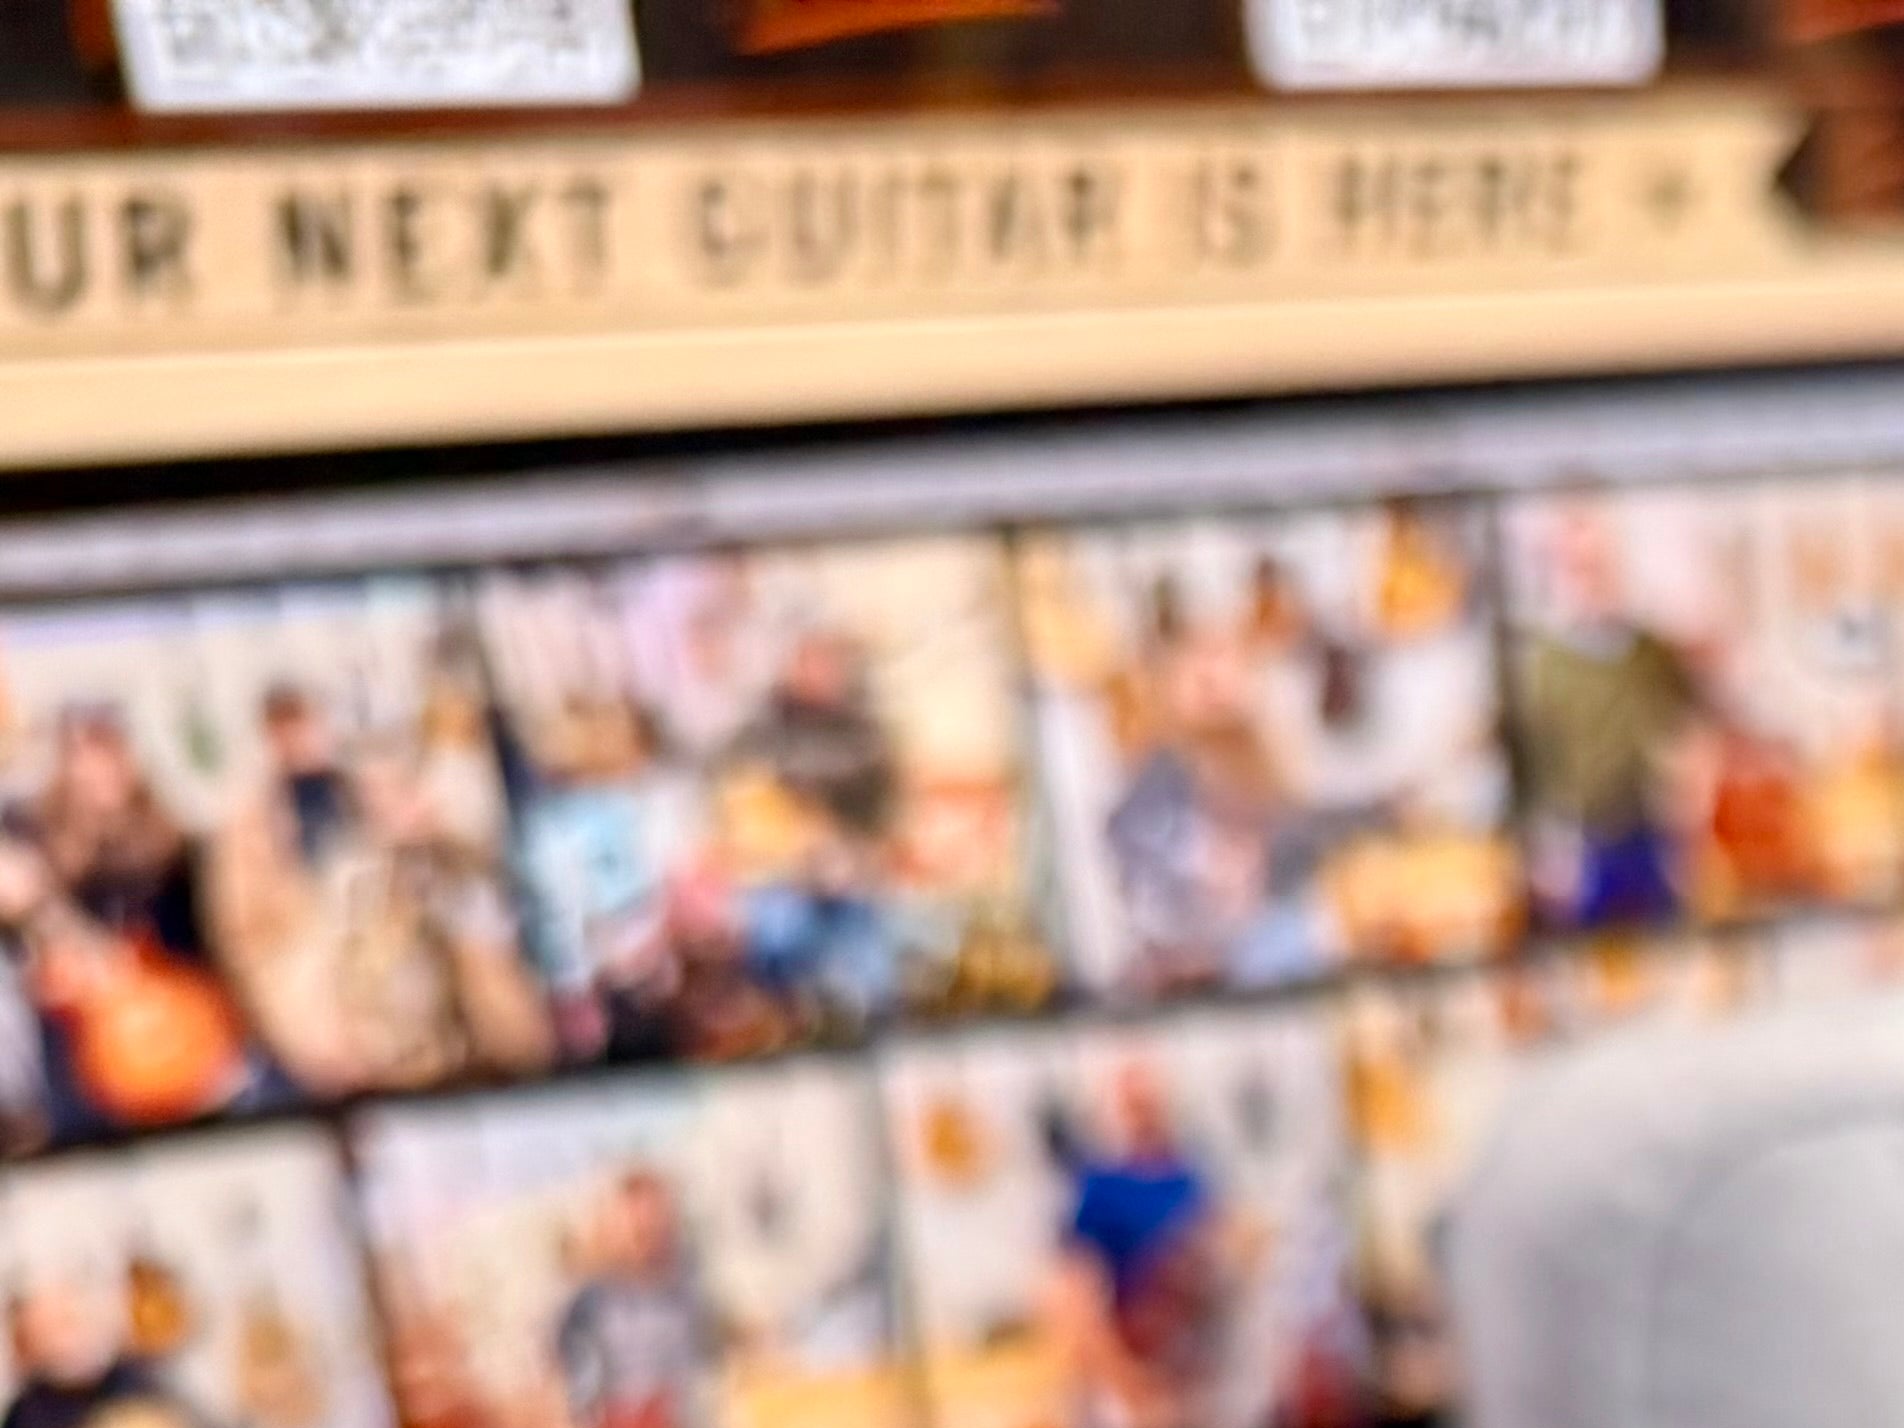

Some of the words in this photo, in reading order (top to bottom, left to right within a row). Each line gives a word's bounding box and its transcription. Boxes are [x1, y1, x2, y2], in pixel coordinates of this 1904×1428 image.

[272, 172, 616, 308] NEXT
[684, 150, 1124, 300] GUITAR
[1190, 150, 1284, 280] IS
[1326, 138, 1590, 268] HERE
